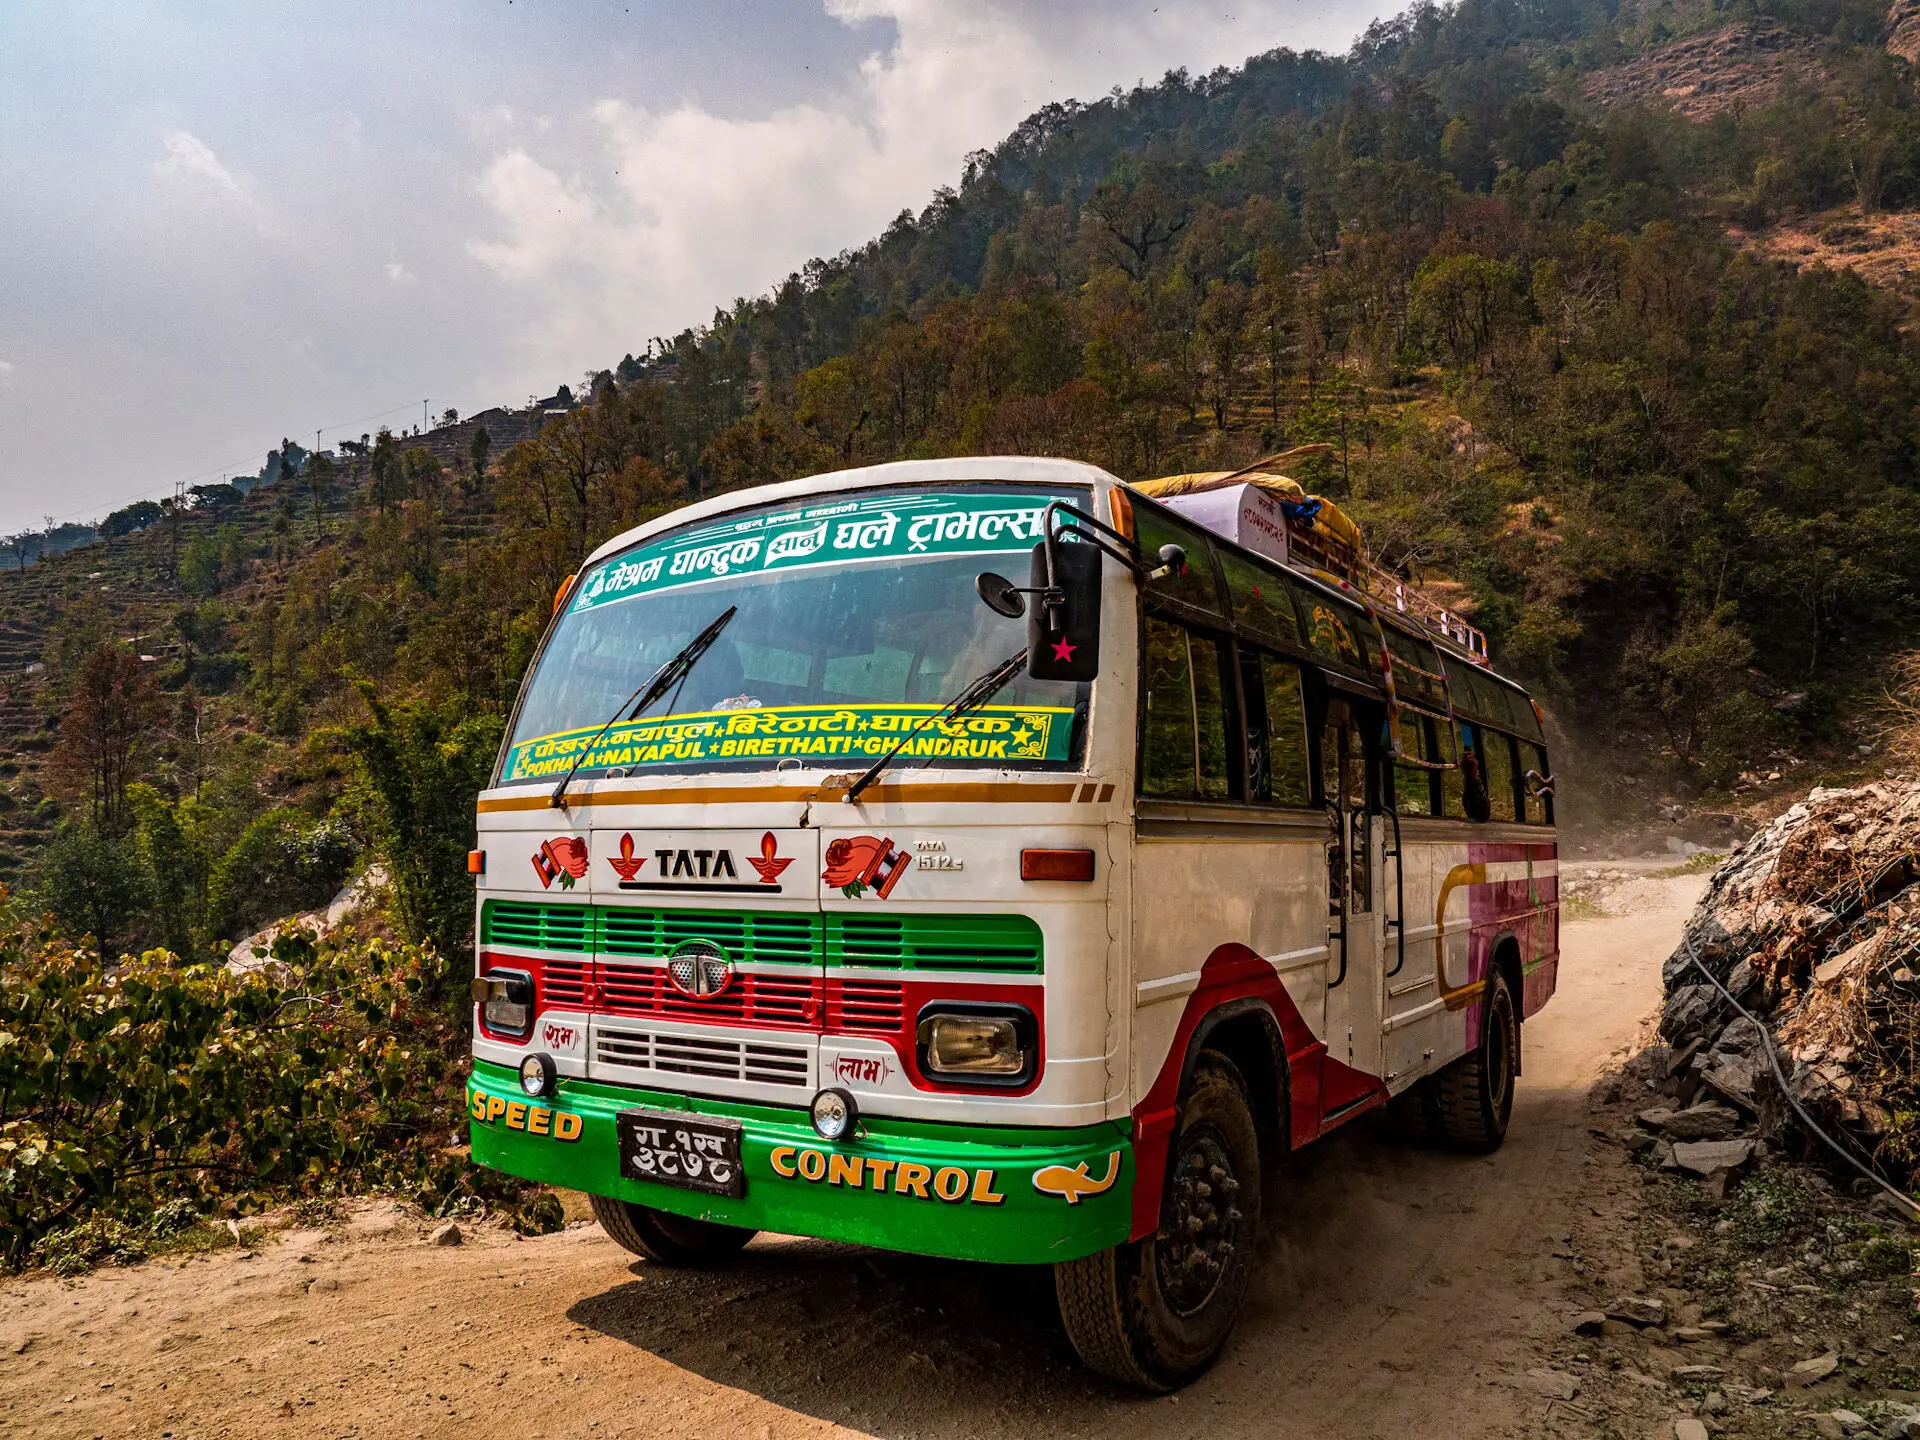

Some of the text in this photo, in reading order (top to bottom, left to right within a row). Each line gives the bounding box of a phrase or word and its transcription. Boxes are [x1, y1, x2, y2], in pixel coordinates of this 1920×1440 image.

[832, 511, 901, 549] घले
[609, 721, 719, 744] नयापुल
[725, 710, 860, 734] बिरेठाटी
[601, 741, 706, 766] NAYAPUL
[719, 735, 853, 757] BIRETHATI
[863, 736, 1009, 759] GHANDRUK
[913, 840, 946, 851] TATA
[655, 849, 737, 878] TATA
[838, 1057, 881, 1087] लाभ
[471, 1089, 583, 1140] SPEED
[770, 1146, 1005, 1203] CONTROL
